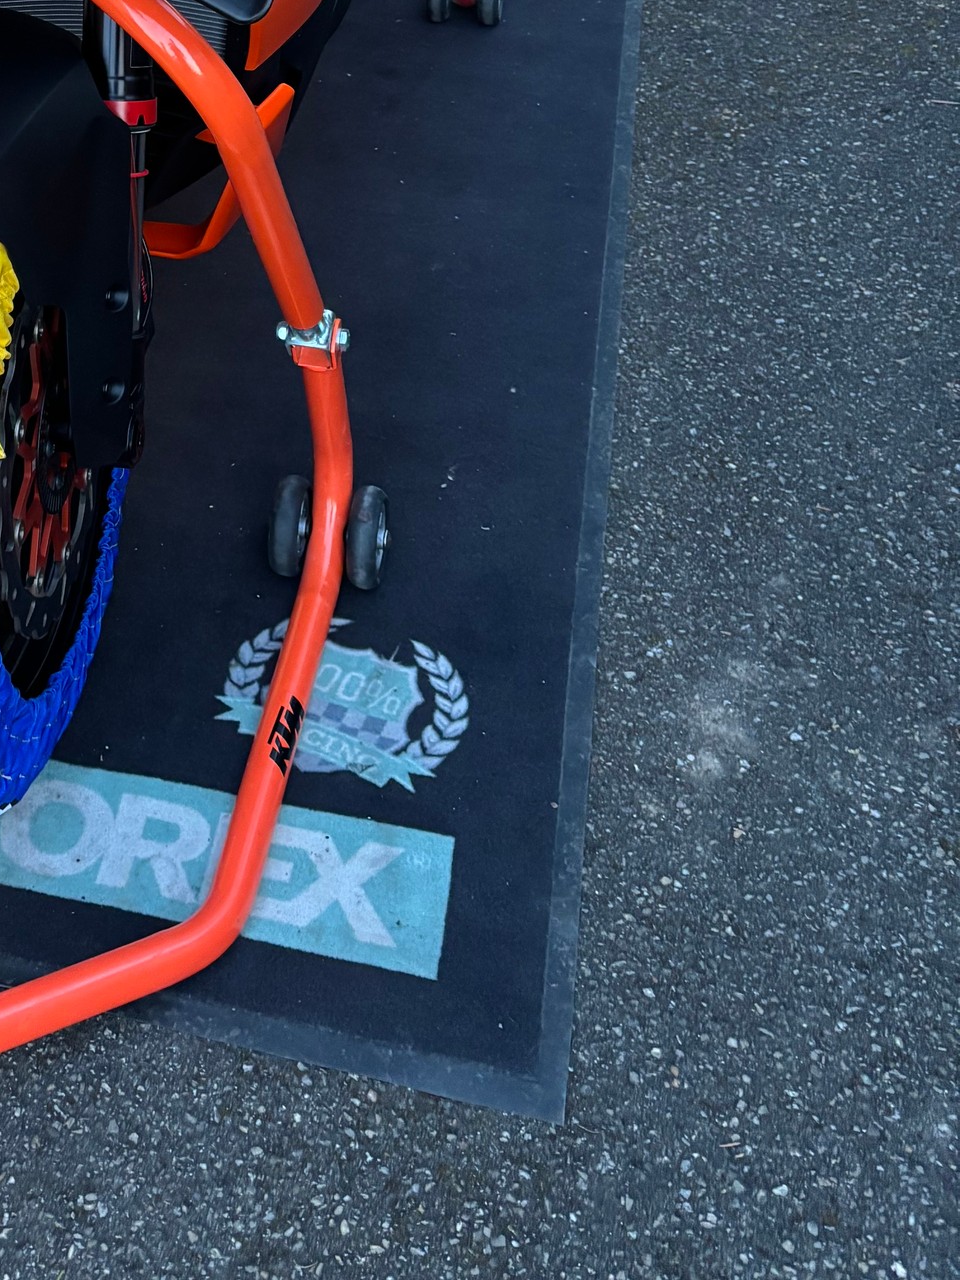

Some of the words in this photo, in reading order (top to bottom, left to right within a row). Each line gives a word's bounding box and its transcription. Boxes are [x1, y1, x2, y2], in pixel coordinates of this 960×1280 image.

[314, 663, 400, 715] 00%
[268, 695, 305, 777] KTM
[305, 729, 380, 767] CING
